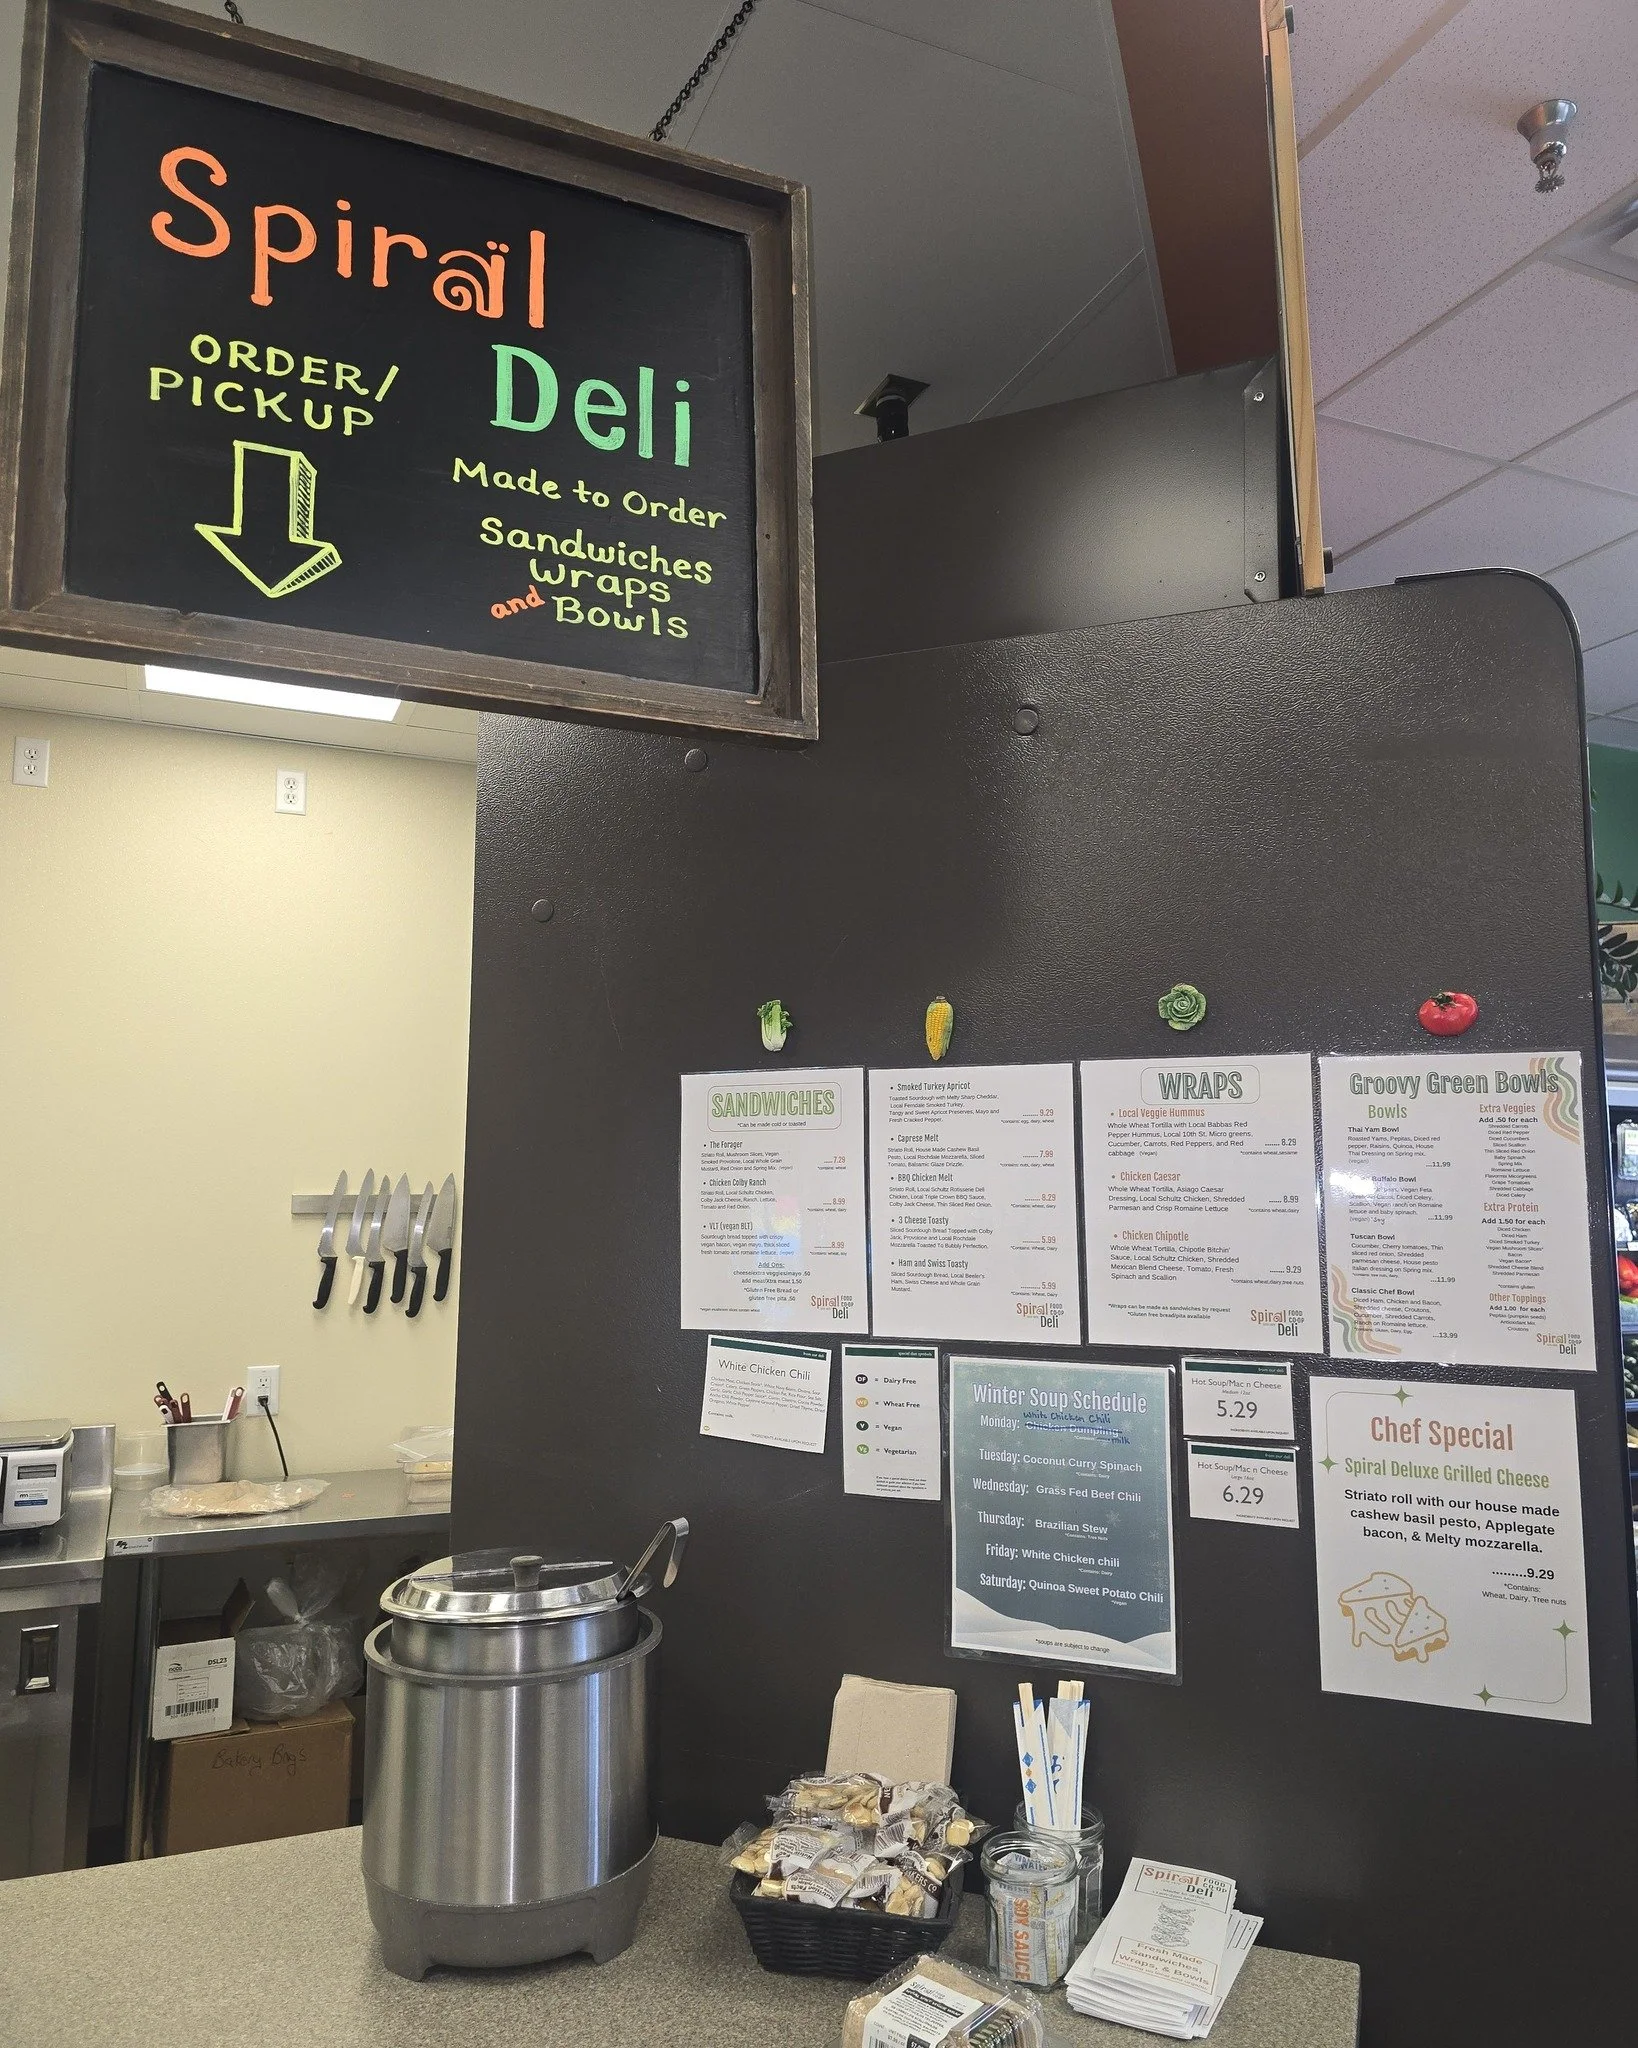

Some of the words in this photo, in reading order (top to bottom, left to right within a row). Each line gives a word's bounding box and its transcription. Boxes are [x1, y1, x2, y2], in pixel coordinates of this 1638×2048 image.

[152, 147, 545, 328] Spiral
[190, 333, 399, 403] ORDER/
[490, 343, 691, 467] Deli
[452, 457, 561, 500] Made
[573, 479, 610, 508] to
[622, 491, 727, 529] Order
[480, 516, 714, 584] Sandwiches
[491, 585, 546, 619] and
[552, 596, 690, 639] Bowls
[898, 1083, 923, 1091] Smoked
[924, 1082, 945, 1092] Turkey
[947, 1082, 970, 1090] Apricot
[1159, 1071, 1242, 1099] WRAPS
[1350, 1072, 1420, 1099] Groovy
[1426, 1071, 1488, 1094] Green
[1495, 1069, 1558, 1093] Bowls
[712, 1090, 835, 1117] SANDWICHES
[1119, 1108, 1139, 1118] Local
[1140, 1108, 1167, 1119] Veggie
[1169, 1108, 1205, 1117] Hummus
[1368, 1104, 1408, 1119] Bowls
[1480, 1104, 1501, 1113] Extra
[1502, 1104, 1536, 1114] Veggies
[721, 1141, 742, 1149] Forager
[1282, 1138, 1296, 1146] 8.29
[733, 1179, 748, 1187] Colby
[898, 1174, 910, 1182] BBQ
[1120, 1172, 1151, 1181] Chicken
[1153, 1172, 1181, 1181] Caesar
[1484, 1203, 1506, 1212] Extra
[1507, 1203, 1539, 1212] Protein
[720, 1222, 740, 1230] (vegan
[741, 1222, 752, 1230] BLT)
[904, 1216, 926, 1224] Cheese
[928, 1217, 949, 1226] Toasty
[1123, 1231, 1153, 1241] Chicken
[1156, 1231, 1189, 1242] Chipotle
[899, 1259, 912, 1267] Ham
[914, 1260, 926, 1268] and
[928, 1259, 946, 1268] Swiss
[947, 1260, 968, 1270] Toasty
[1489, 1293, 1510, 1302] Other
[1512, 1294, 1546, 1304] Toppings
[718, 1359, 746, 1372] White
[750, 1364, 786, 1377] Chicken
[789, 1368, 811, 1380] Chili
[1192, 1378, 1206, 1386] Hot
[1208, 1379, 1244, 1388] Soup/Mac
[1254, 1381, 1282, 1390] Cheese
[972, 1384, 1025, 1405] Winter
[1030, 1387, 1069, 1412] Soup
[1072, 1390, 1147, 1413] Schedule
[1217, 1400, 1258, 1418] 5.29
[980, 1415, 1020, 1430] Monday:
[1051, 1412, 1085, 1422] Chicken
[1089, 1413, 1111, 1423] Chili
[1371, 1416, 1422, 1445] Chef
[1428, 1420, 1513, 1452] Special
[883, 1448, 917, 1456] Vegetarian
[979, 1448, 1021, 1464] Tuesday:
[1023, 1454, 1066, 1466] Coconut
[1068, 1459, 1097, 1470] Curry
[1099, 1461, 1142, 1472] Spinach
[1345, 1458, 1386, 1478] Spiral
[1391, 1461, 1440, 1480] Deluxe
[1443, 1464, 1492, 1484] Grilled
[1496, 1469, 1549, 1489] Cheese
[972, 1477, 1029, 1494] Wednesday:
[1036, 1485, 1066, 1496] Grass
[1069, 1488, 1088, 1498] Fed
[1091, 1490, 1115, 1499] Beef
[1117, 1492, 1141, 1502] Chili
[1223, 1485, 1264, 1504] 6.29
[1345, 1489, 1387, 1503] Striato
[1391, 1494, 1413, 1505] roll
[1417, 1495, 1445, 1508] with
[1448, 1499, 1471, 1510] our
[1475, 1499, 1518, 1514] house
[1521, 1504, 1560, 1517] made
[978, 1511, 1025, 1527] Thursday:
[1035, 1519, 1079, 1532] Brazilian
[1082, 1523, 1108, 1534] Stew
[1350, 1508, 1400, 1523] cashew
[1403, 1511, 1435, 1525] basil
[1439, 1516, 1482, 1530] pesto,
[1485, 1519, 1556, 1536] Applegate
[1362, 1527, 1408, 1542] bacon,
[1411, 1532, 1422, 1542] &
[1425, 1532, 1461, 1547] Melty
[1465, 1537, 1543, 1554] mozzarella.
[986, 1543, 1019, 1559] Friday:
[1021, 1549, 1051, 1561] White
[1053, 1552, 1095, 1565] Chicken
[1097, 1557, 1120, 1568] chili
[980, 1573, 1026, 1592] Saturday:
[1029, 1580, 1065, 1593] Quinoa
[1068, 1584, 1099, 1596] Sweet
[1102, 1588, 1136, 1600] Potato
[1139, 1592, 1163, 1603] Chili
[1482, 1591, 1508, 1600] Wheat,
[1509, 1592, 1531, 1603] Dairy,
[1532, 1595, 1549, 1604] Tree
[1551, 1598, 1567, 1606] nuts
[1064, 1641, 1083, 1650] subject
[1090, 1645, 1110, 1654] change
[208, 1657, 228, 1666] DSL23
[1144, 1867, 1201, 1885] Spiral
[1187, 1885, 1213, 1898] Deli
[1014, 1898, 1029, 1927] SOY
[1014, 1930, 1031, 1980] SAUCE
[1130, 1949, 1202, 1974] Sandwiches,
[1137, 1943, 1169, 1956] Fresh
[1173, 1953, 1203, 1964] Made
[1119, 1954, 1158, 1970] Wraps,
[1173, 1970, 1210, 1985] Bowls
